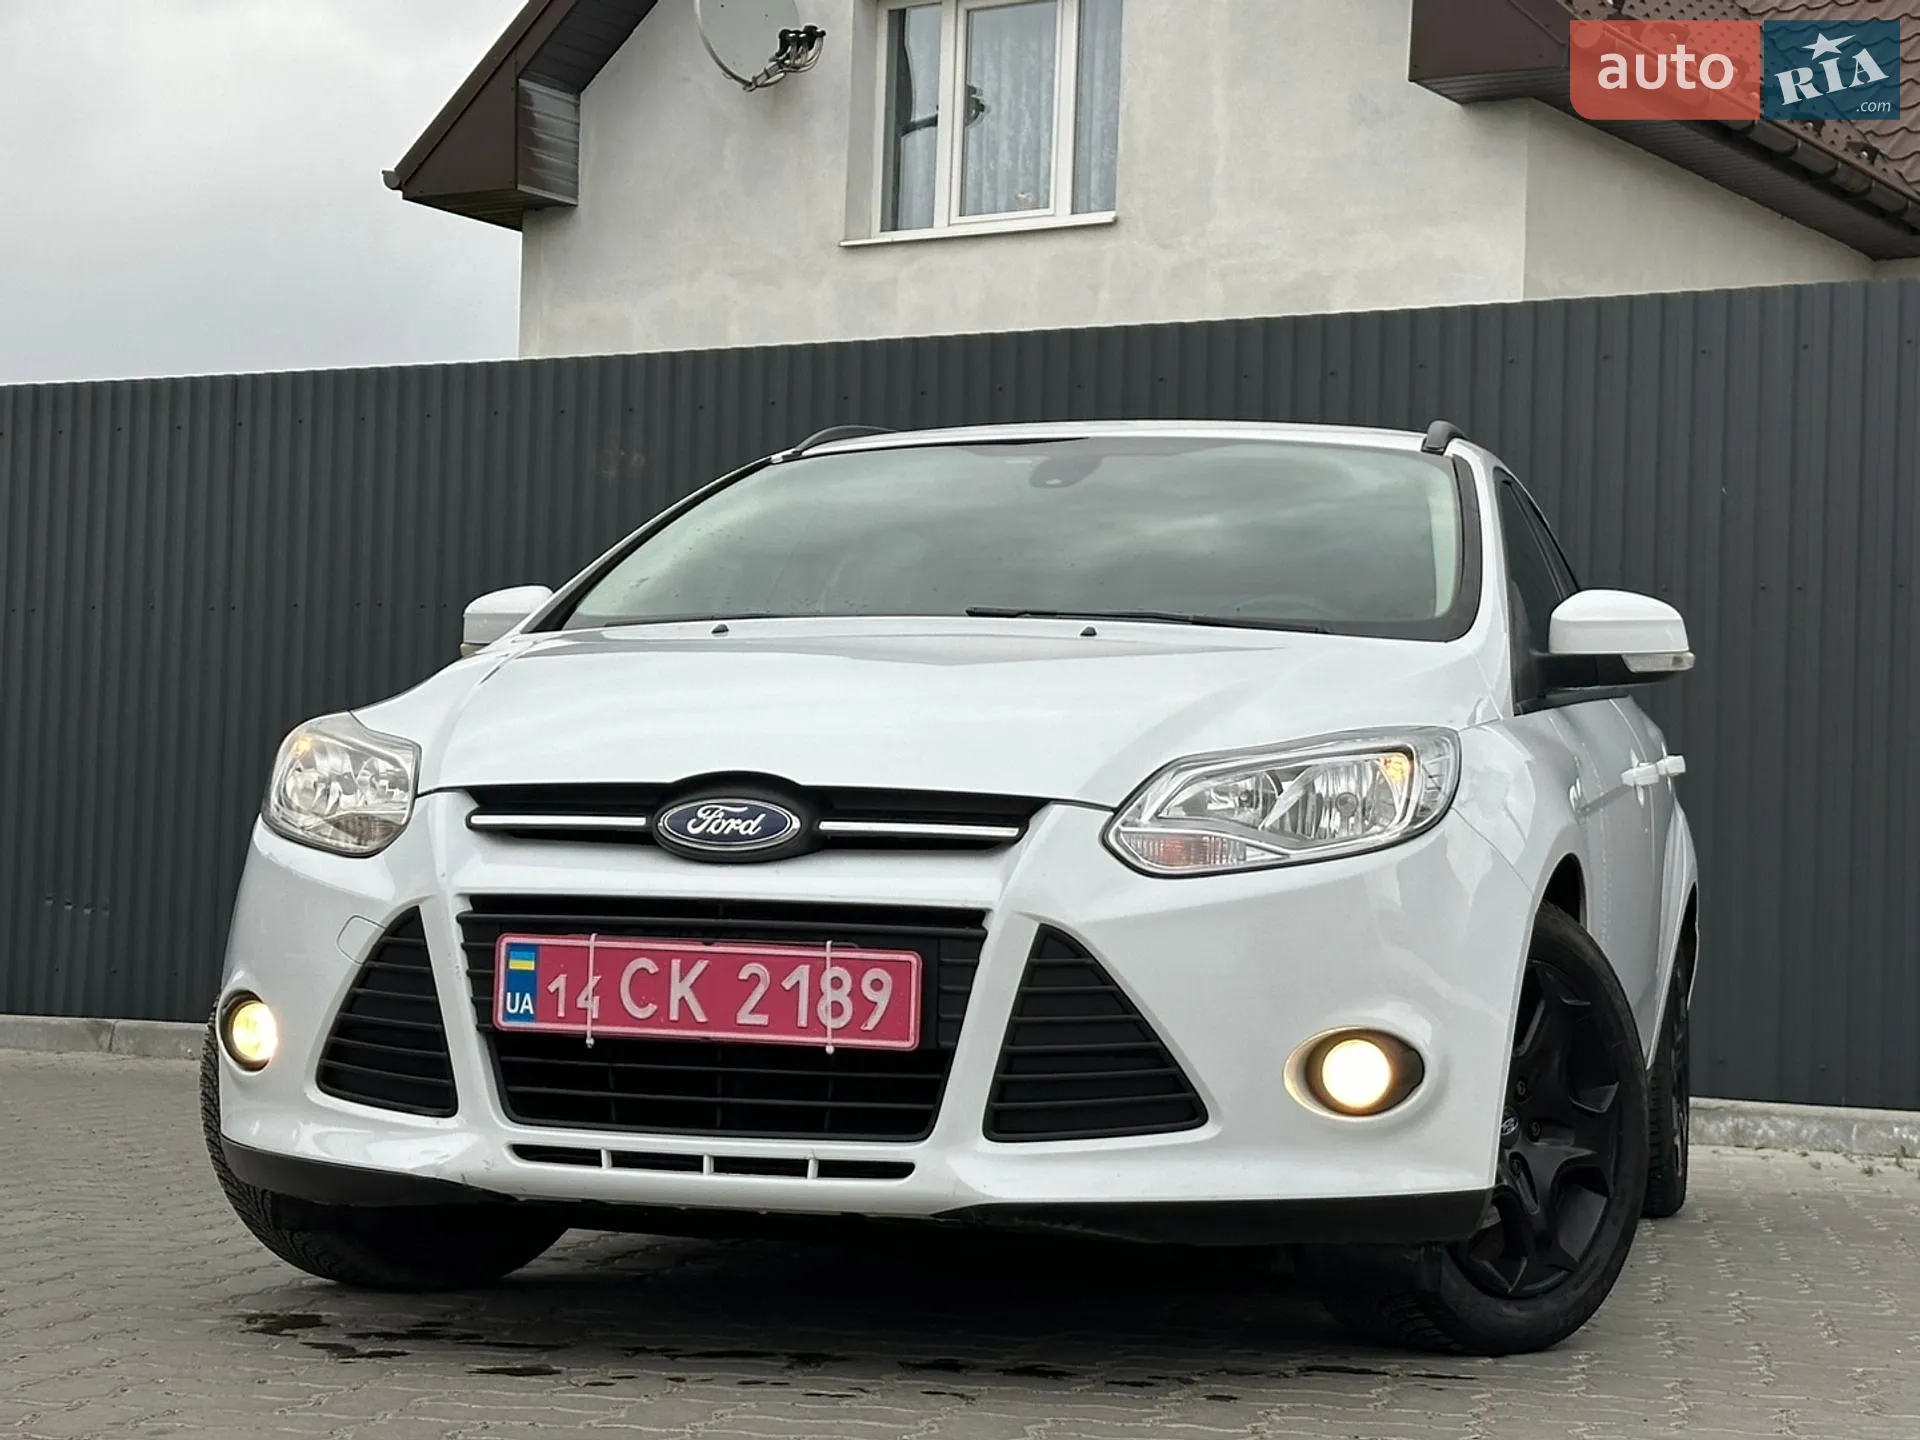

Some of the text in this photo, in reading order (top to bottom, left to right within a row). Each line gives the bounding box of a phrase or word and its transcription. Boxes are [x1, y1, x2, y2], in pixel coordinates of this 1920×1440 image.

[686, 804, 766, 836] Ford
[505, 991, 535, 1015] UA
[547, 957, 894, 1031] 14 CK 2189
